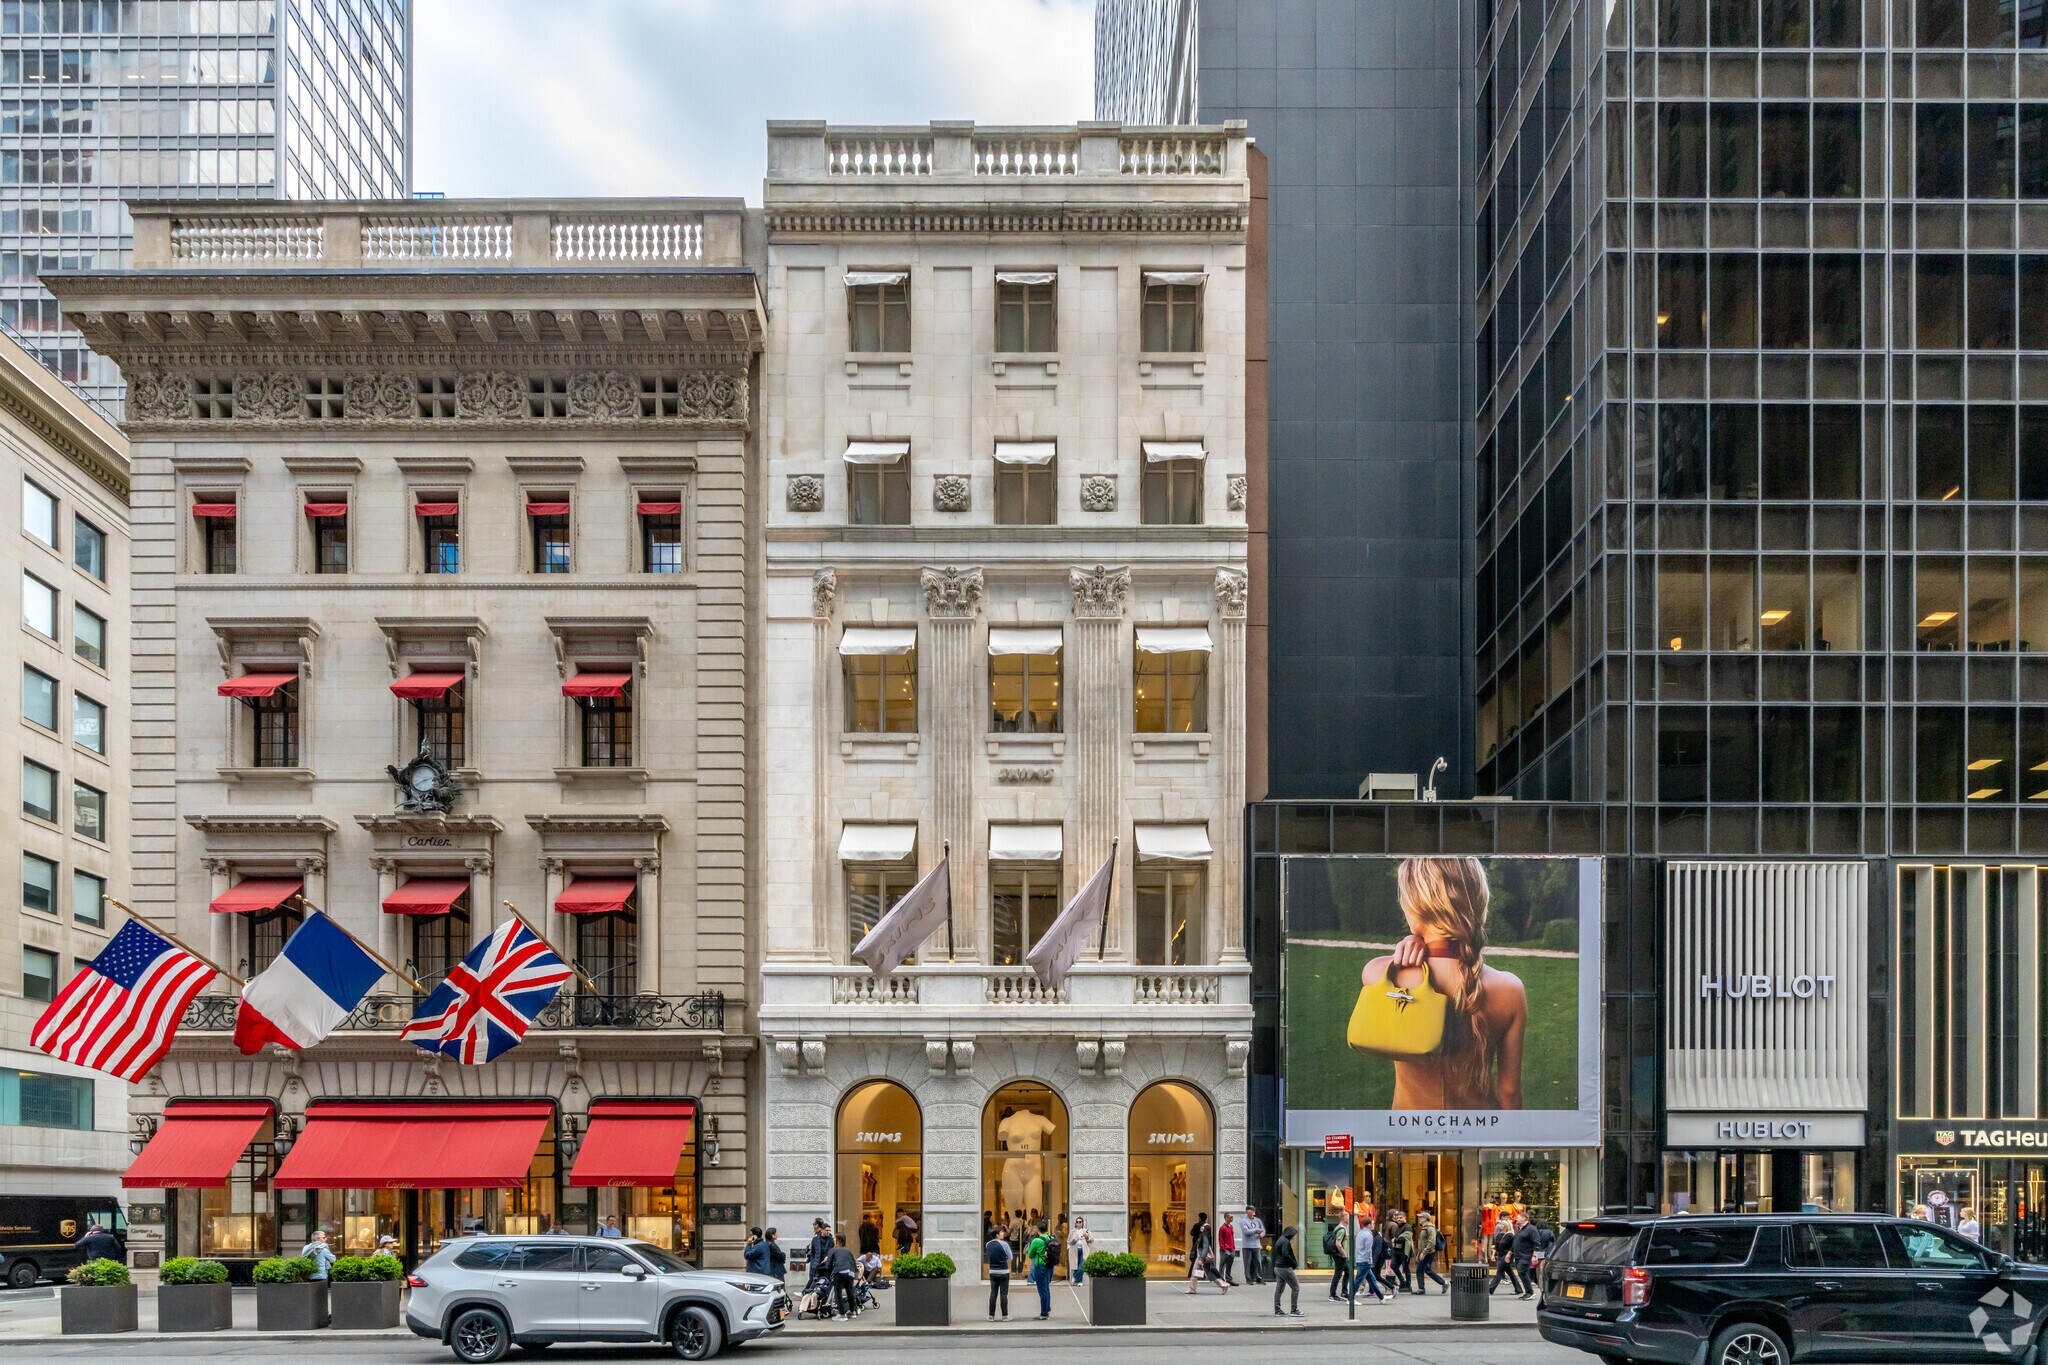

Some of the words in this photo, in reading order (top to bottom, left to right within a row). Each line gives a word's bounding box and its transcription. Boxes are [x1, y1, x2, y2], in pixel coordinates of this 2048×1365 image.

[408, 836, 452, 847] Cartier
[1701, 975, 1835, 998] HUBLOT
[1388, 1115, 1499, 1127] LONGCHAMP
[1718, 1121, 1813, 1139] HUBLOT
[855, 1132, 902, 1143] SKIMS
[1147, 1133, 1195, 1144] SKIMS
[160, 1179, 188, 1188] Cartier
[386, 1180, 415, 1189] Cartier
[607, 1177, 637, 1187] Cartier
[62, 1225, 76, 1235] ups
[1157, 1254, 1186, 1262] SKIMS
